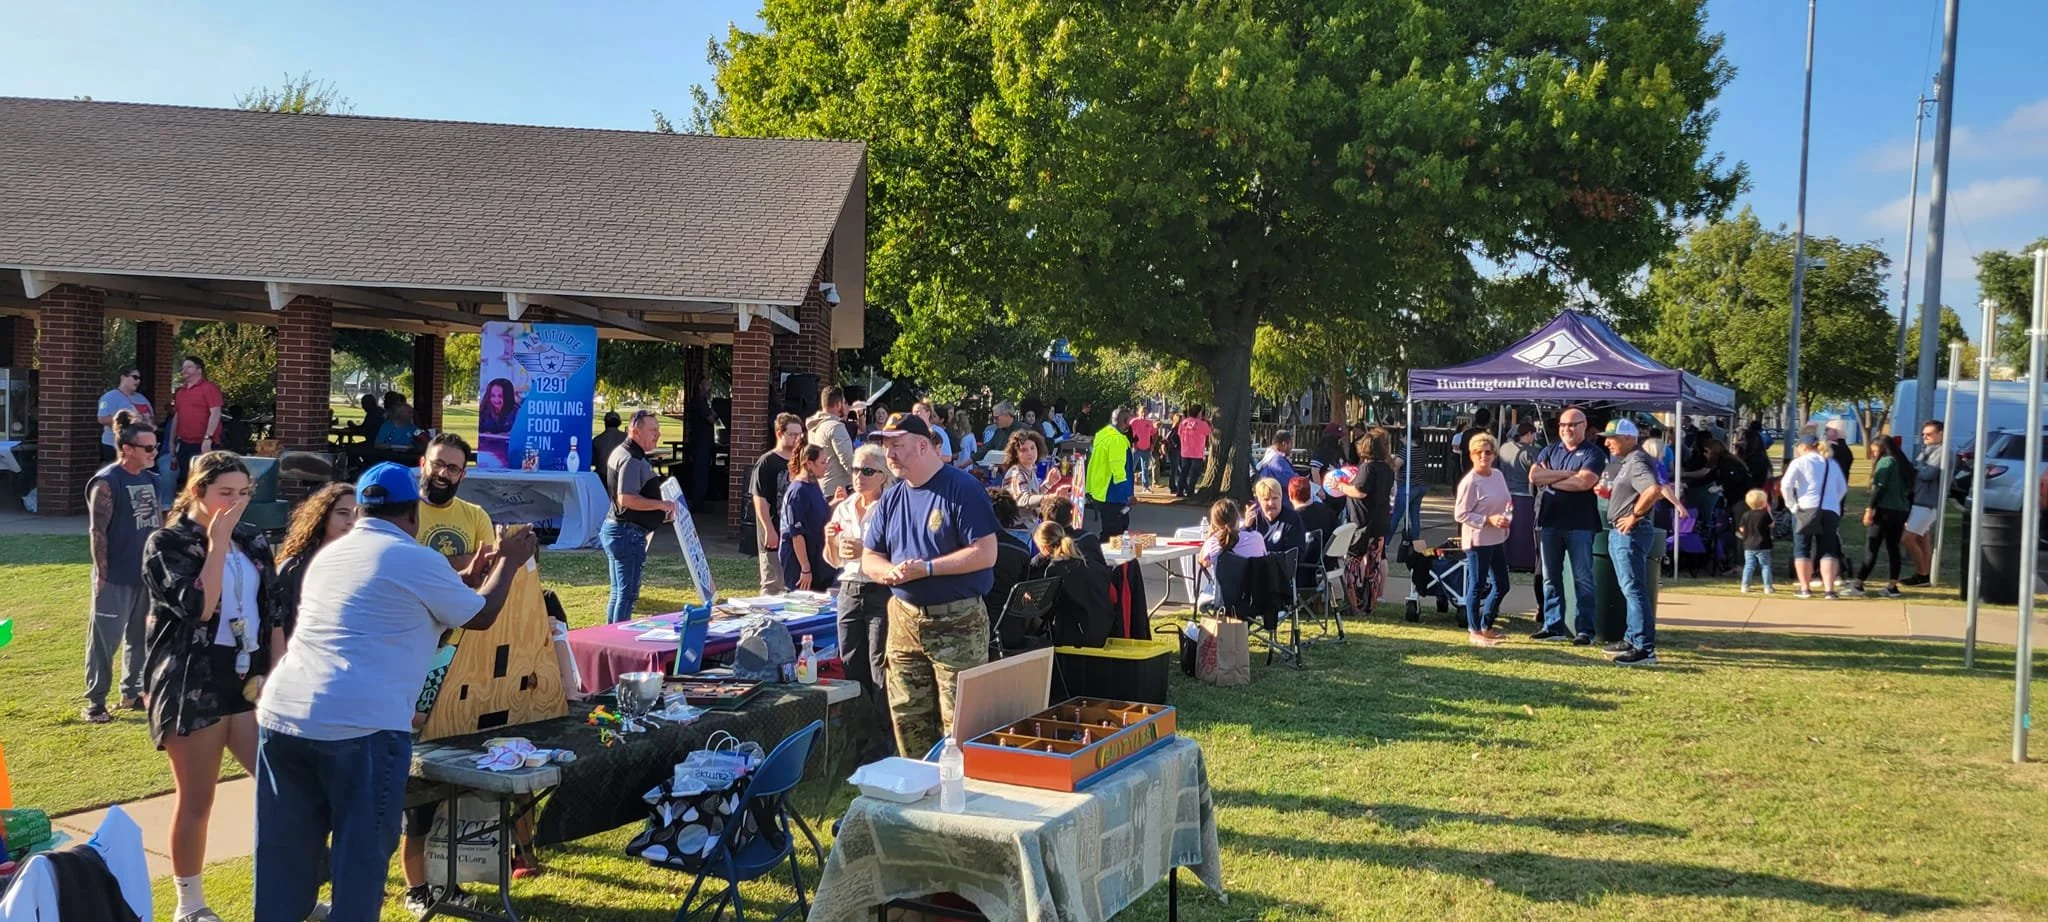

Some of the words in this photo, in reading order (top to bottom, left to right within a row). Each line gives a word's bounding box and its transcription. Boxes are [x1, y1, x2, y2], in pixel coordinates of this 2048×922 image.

[522, 330, 582, 351] ALTITUDE
[535, 376, 567, 394] 1291
[1436, 376, 1650, 392] HuntingtonFineJewelers.com
[527, 400, 586, 416] BOWLING.
[527, 418, 563, 433] FOOD.
